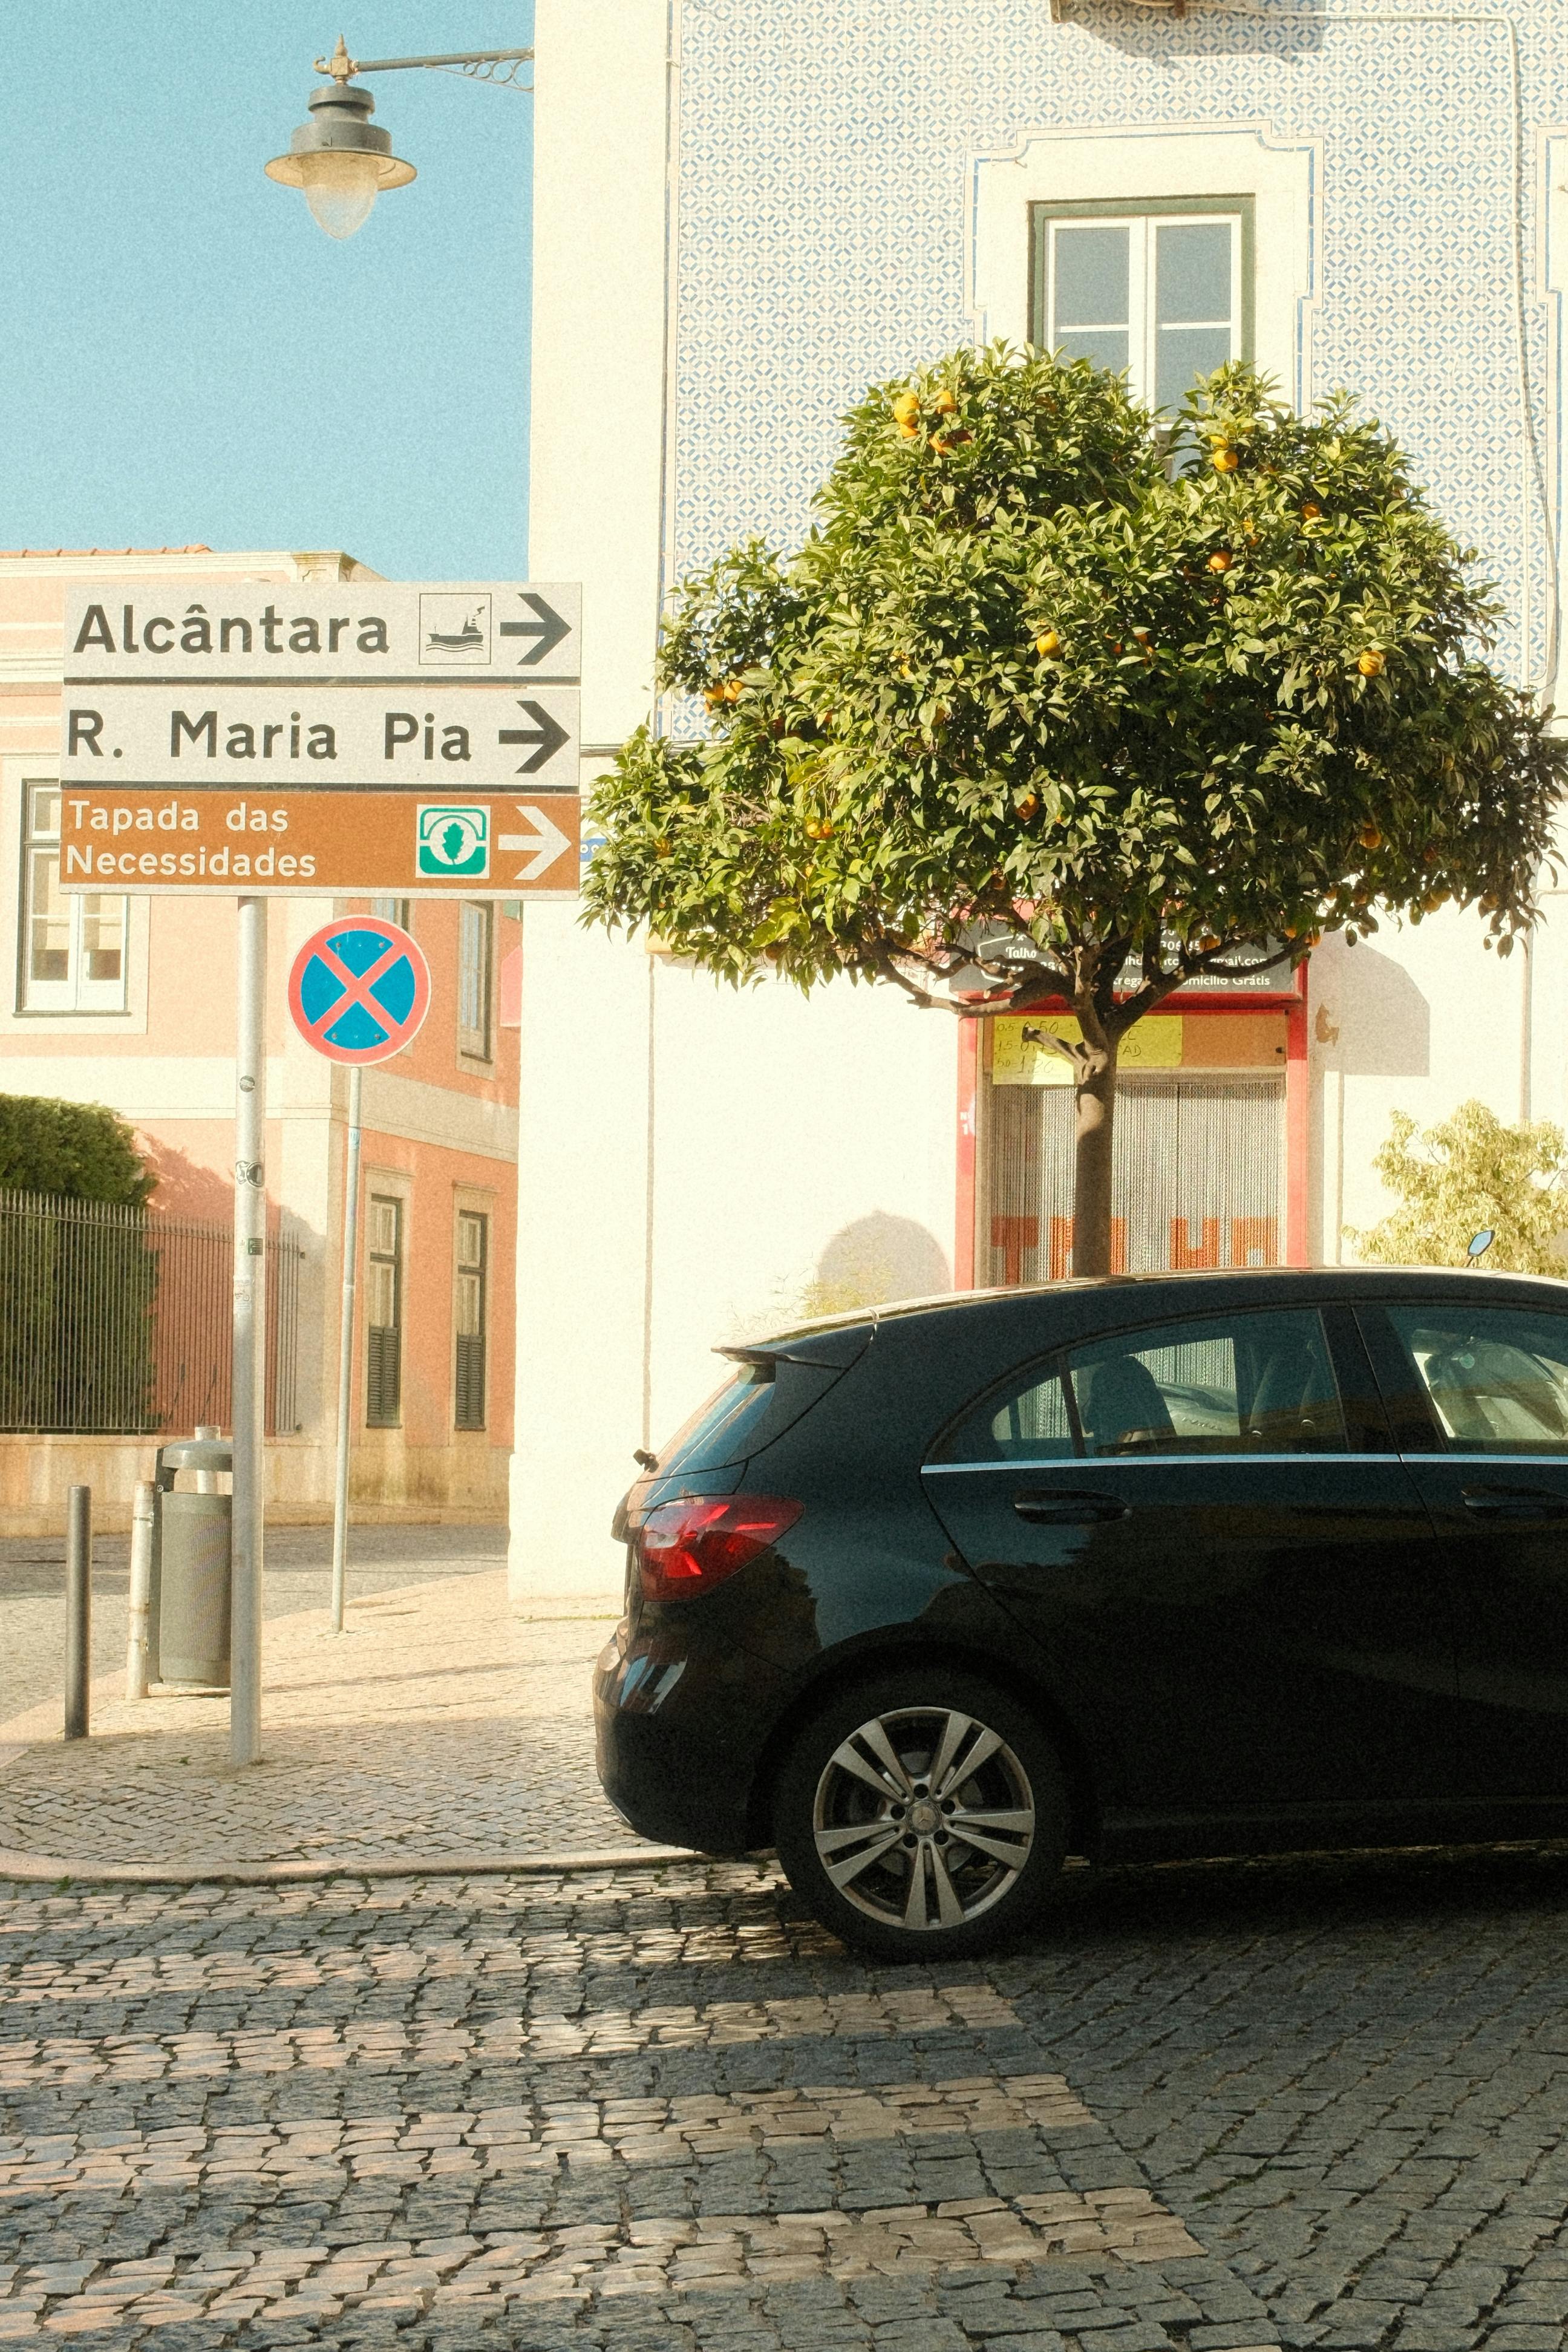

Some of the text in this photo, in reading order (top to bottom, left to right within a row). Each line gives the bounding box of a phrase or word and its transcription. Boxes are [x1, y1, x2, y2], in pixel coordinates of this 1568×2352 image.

[73, 604, 390, 654] Alcântara
[68, 709, 472, 762] R. Maria Pia
[68, 800, 289, 836] Tapada das
[66, 844, 316, 877] Necessidades
[1005, 947, 1037, 959] Talho
